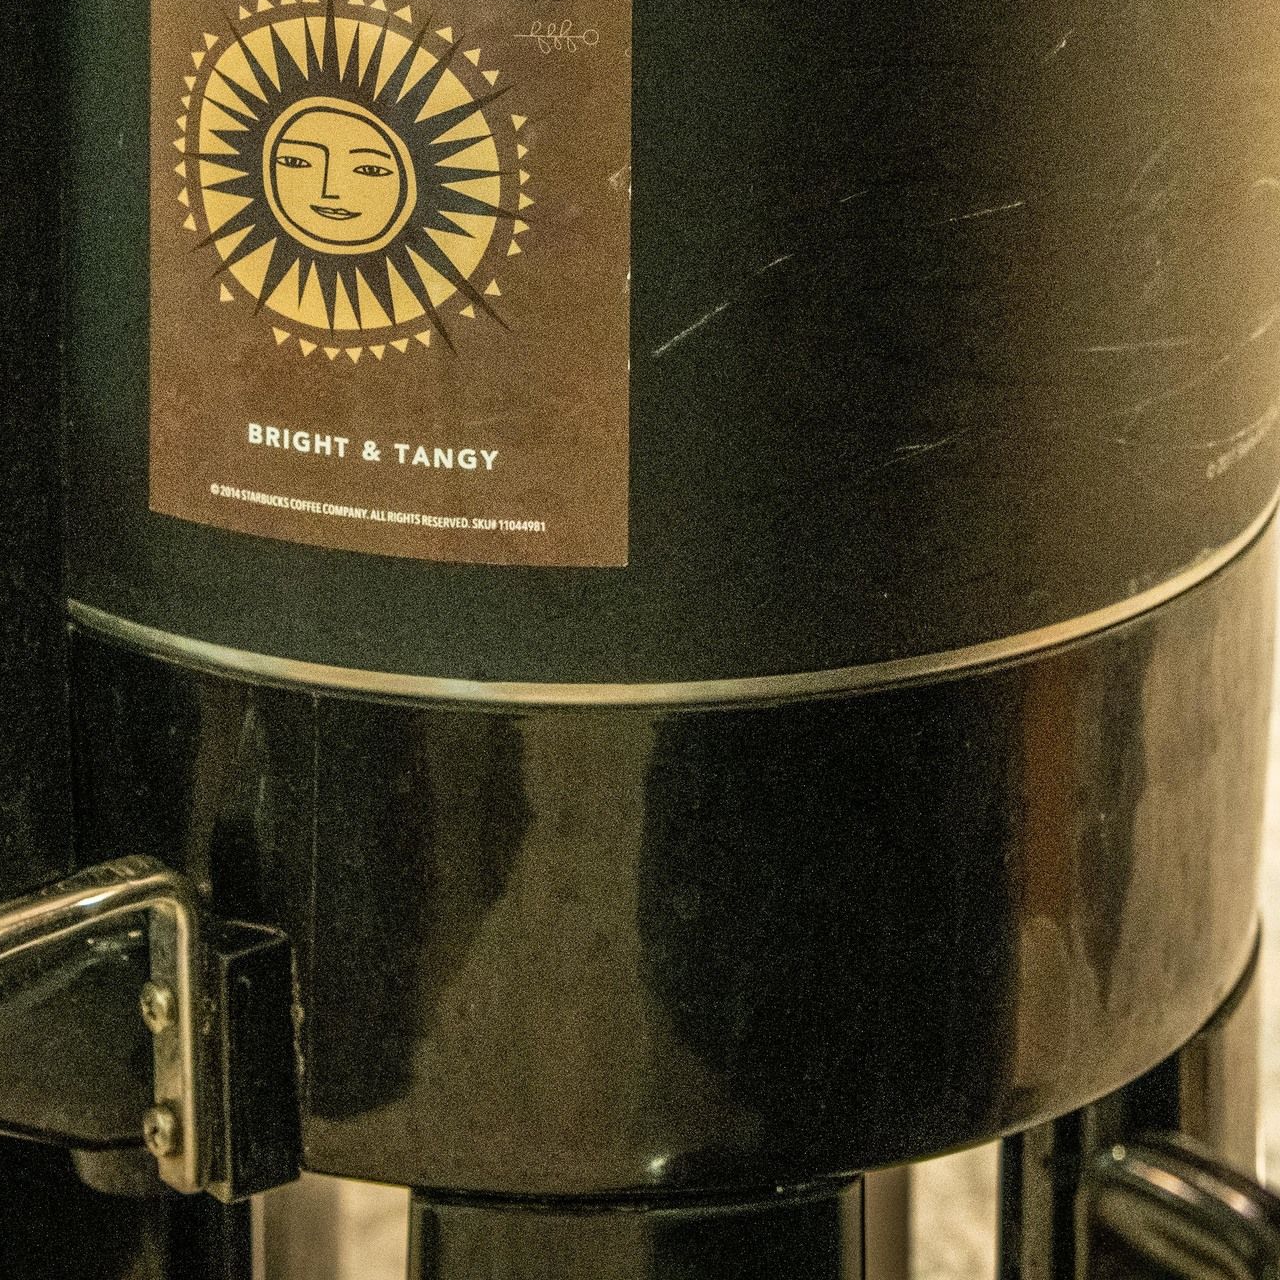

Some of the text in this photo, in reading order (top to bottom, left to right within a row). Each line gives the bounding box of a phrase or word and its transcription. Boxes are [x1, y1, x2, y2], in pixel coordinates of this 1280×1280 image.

[248, 422, 499, 472] BRIGHT & TANGY
[220, 485, 241, 500] 2014
[241, 489, 289, 508] STARBUCKS
[290, 498, 322, 514] COFFEE
[322, 503, 370, 520] COMPANY.
[370, 509, 388, 522] ALL
[388, 511, 420, 525] RIGHTS
[421, 514, 470, 529] RESERVED.
